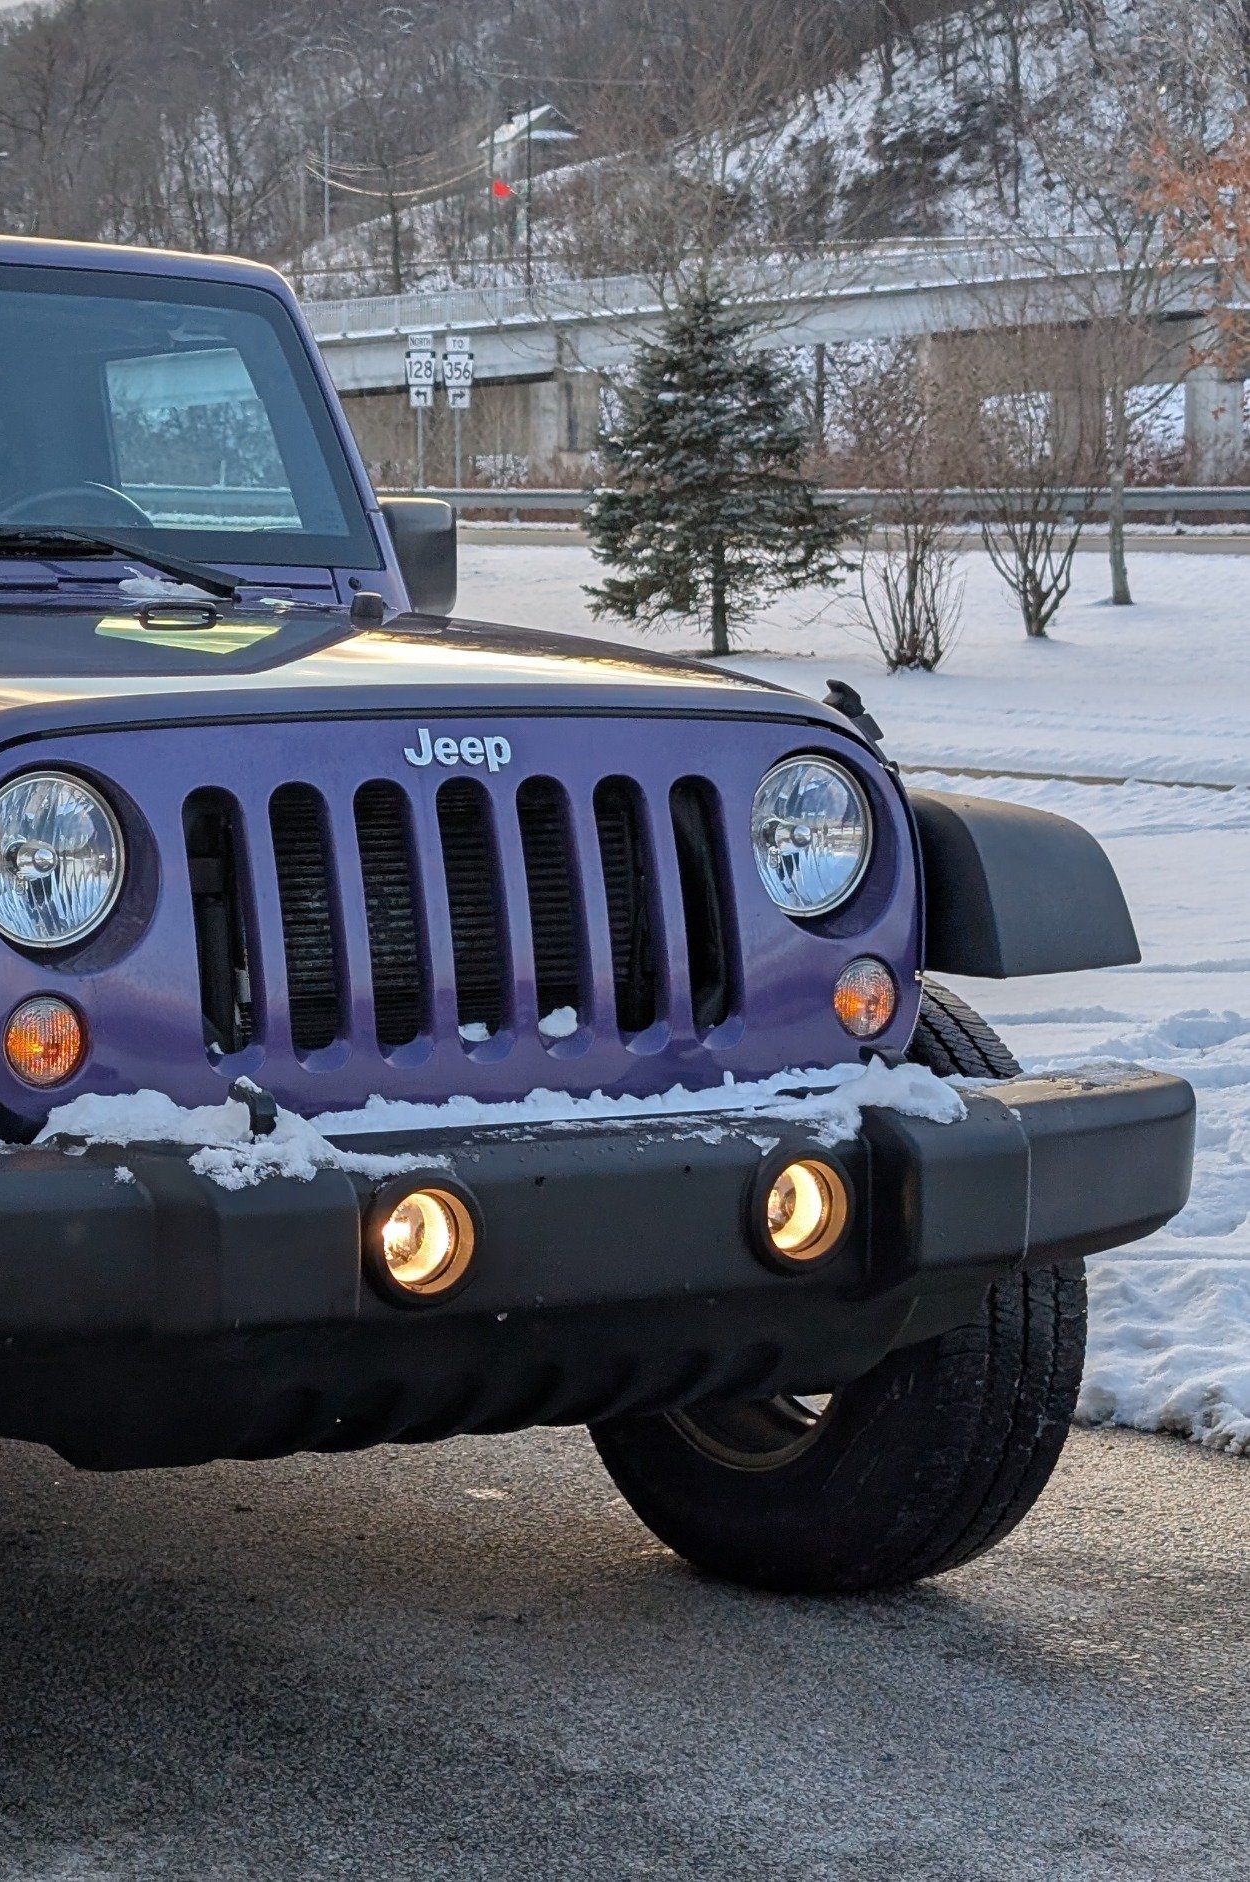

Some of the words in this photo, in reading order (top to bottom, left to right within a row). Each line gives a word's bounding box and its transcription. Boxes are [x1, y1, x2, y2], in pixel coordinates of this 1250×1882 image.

[410, 337, 430, 346] NORTH
[452, 339, 464, 349] TO
[408, 360, 433, 379] 128
[445, 361, 471, 381] 356
[403, 728, 512, 773] Jeep
